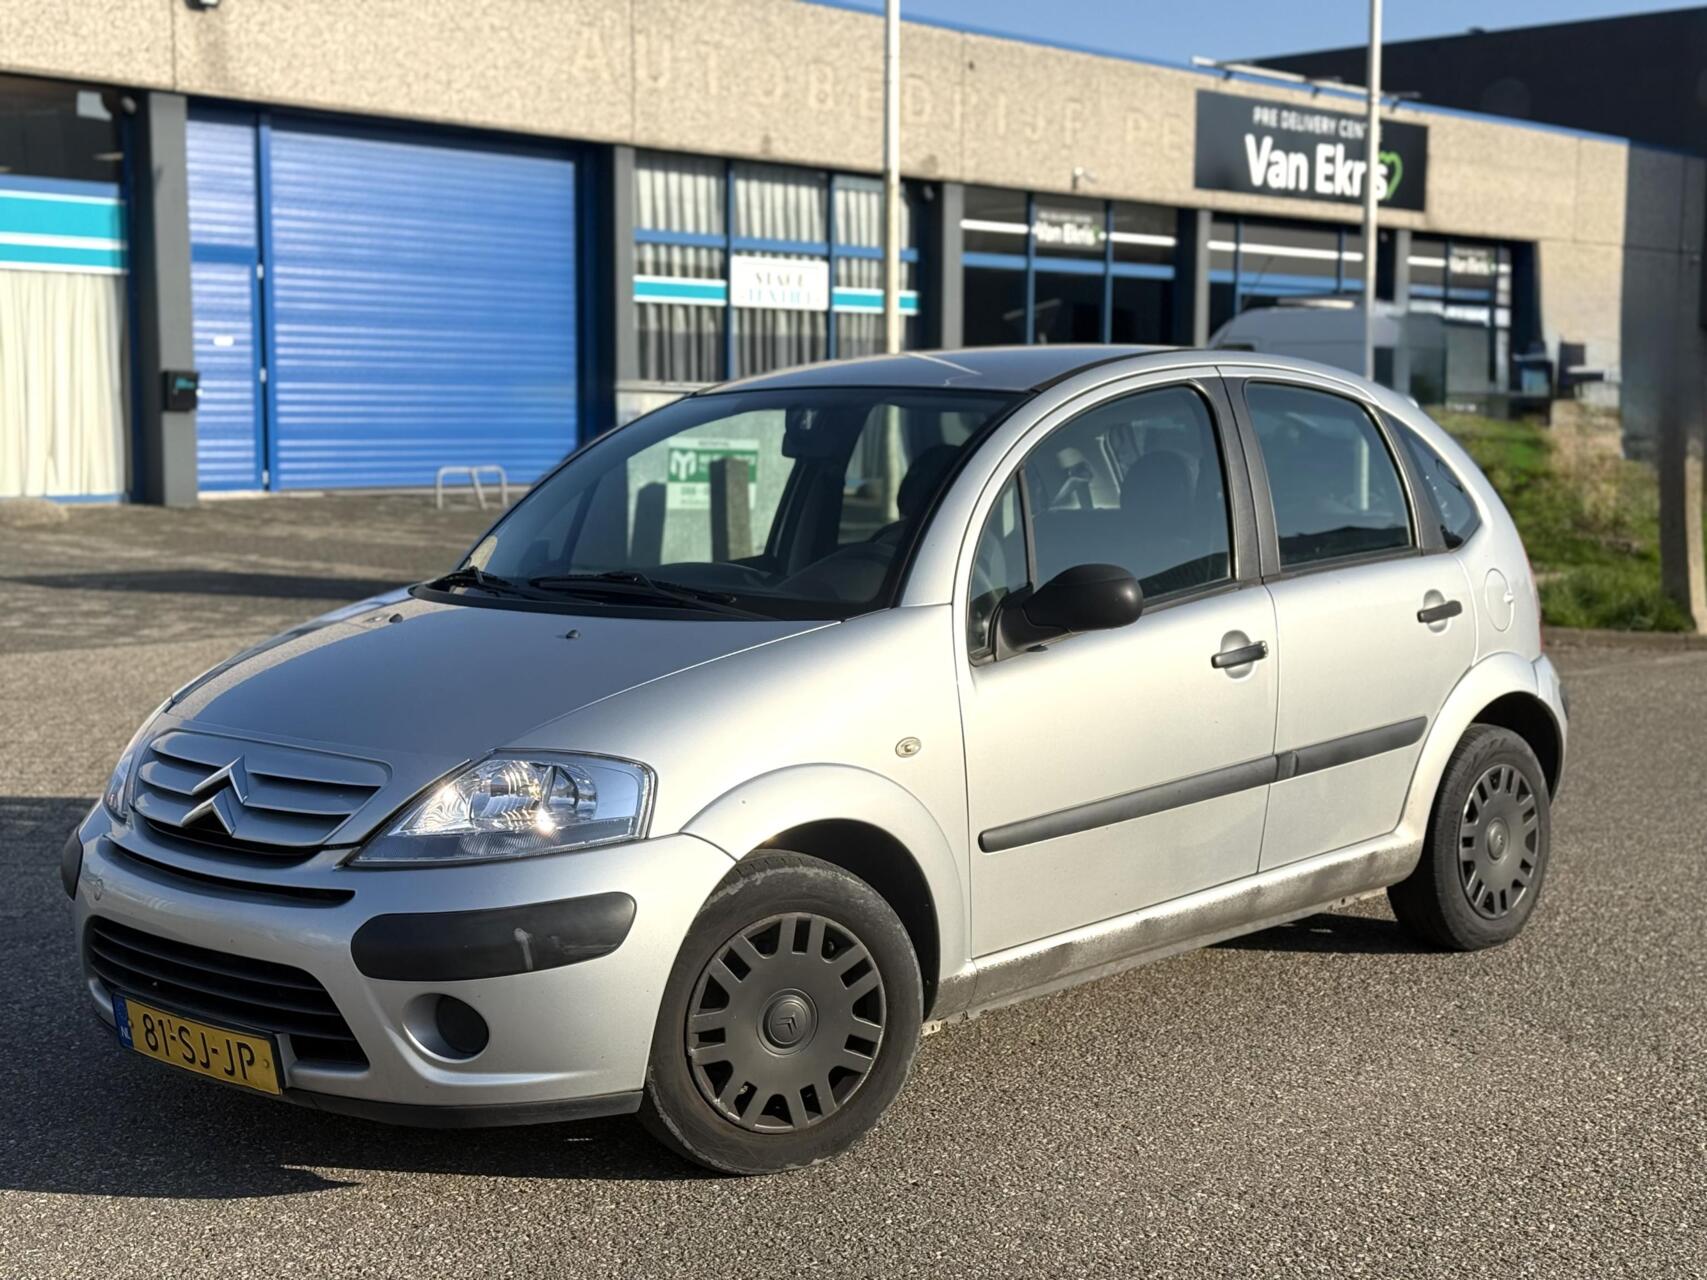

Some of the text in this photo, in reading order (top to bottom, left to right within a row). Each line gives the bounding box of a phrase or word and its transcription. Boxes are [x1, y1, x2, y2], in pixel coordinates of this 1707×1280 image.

[1253, 106, 1279, 129] PRE
[1281, 110, 1338, 135] DELIVERY
[1245, 133, 1389, 200] Van Ekrs
[120, 1013, 256, 1080] NL 81-SJ-JP
